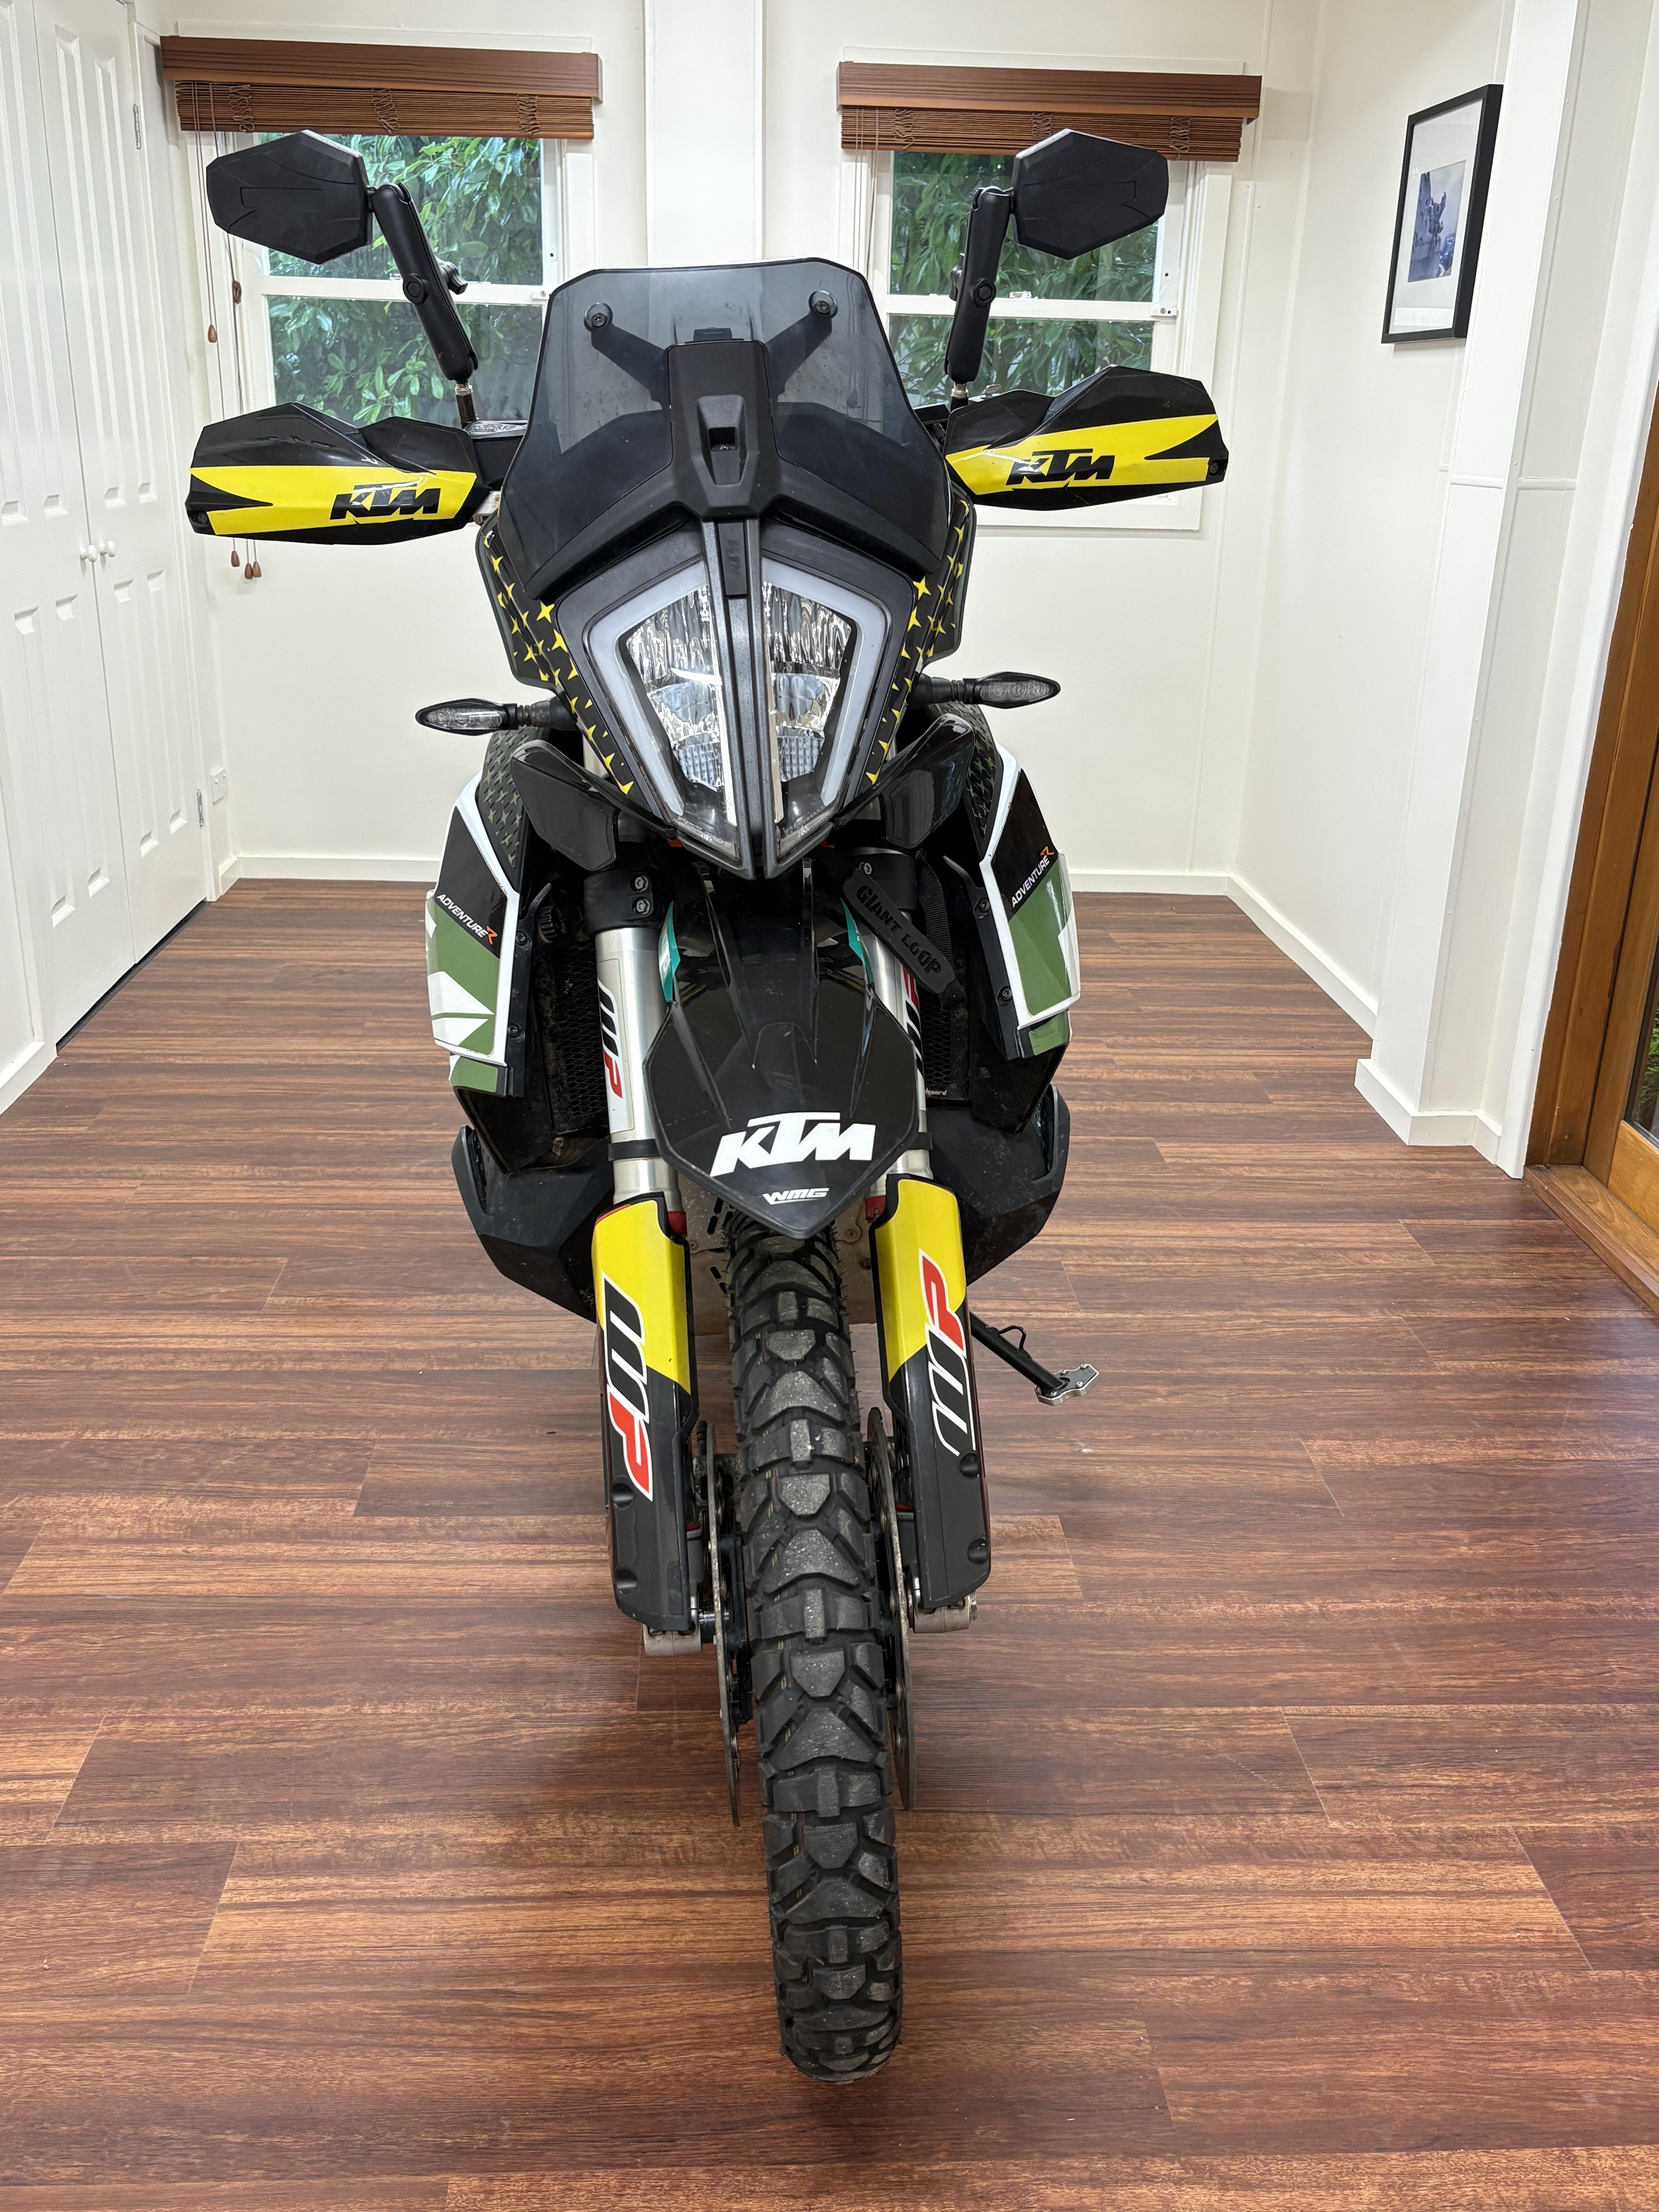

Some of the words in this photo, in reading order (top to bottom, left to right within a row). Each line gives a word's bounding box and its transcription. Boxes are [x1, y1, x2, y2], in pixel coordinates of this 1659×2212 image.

[1006, 448, 1115, 486] KTM
[330, 481, 441, 520] KTM
[1012, 855, 1050, 908] ADVENTURE
[437, 894, 488, 938] ADVENTURE
[857, 886, 902, 932] GIANT
[901, 933, 941, 974] LOOP
[710, 1112, 876, 1177] KTM
[763, 1188, 829, 1205] WMG
